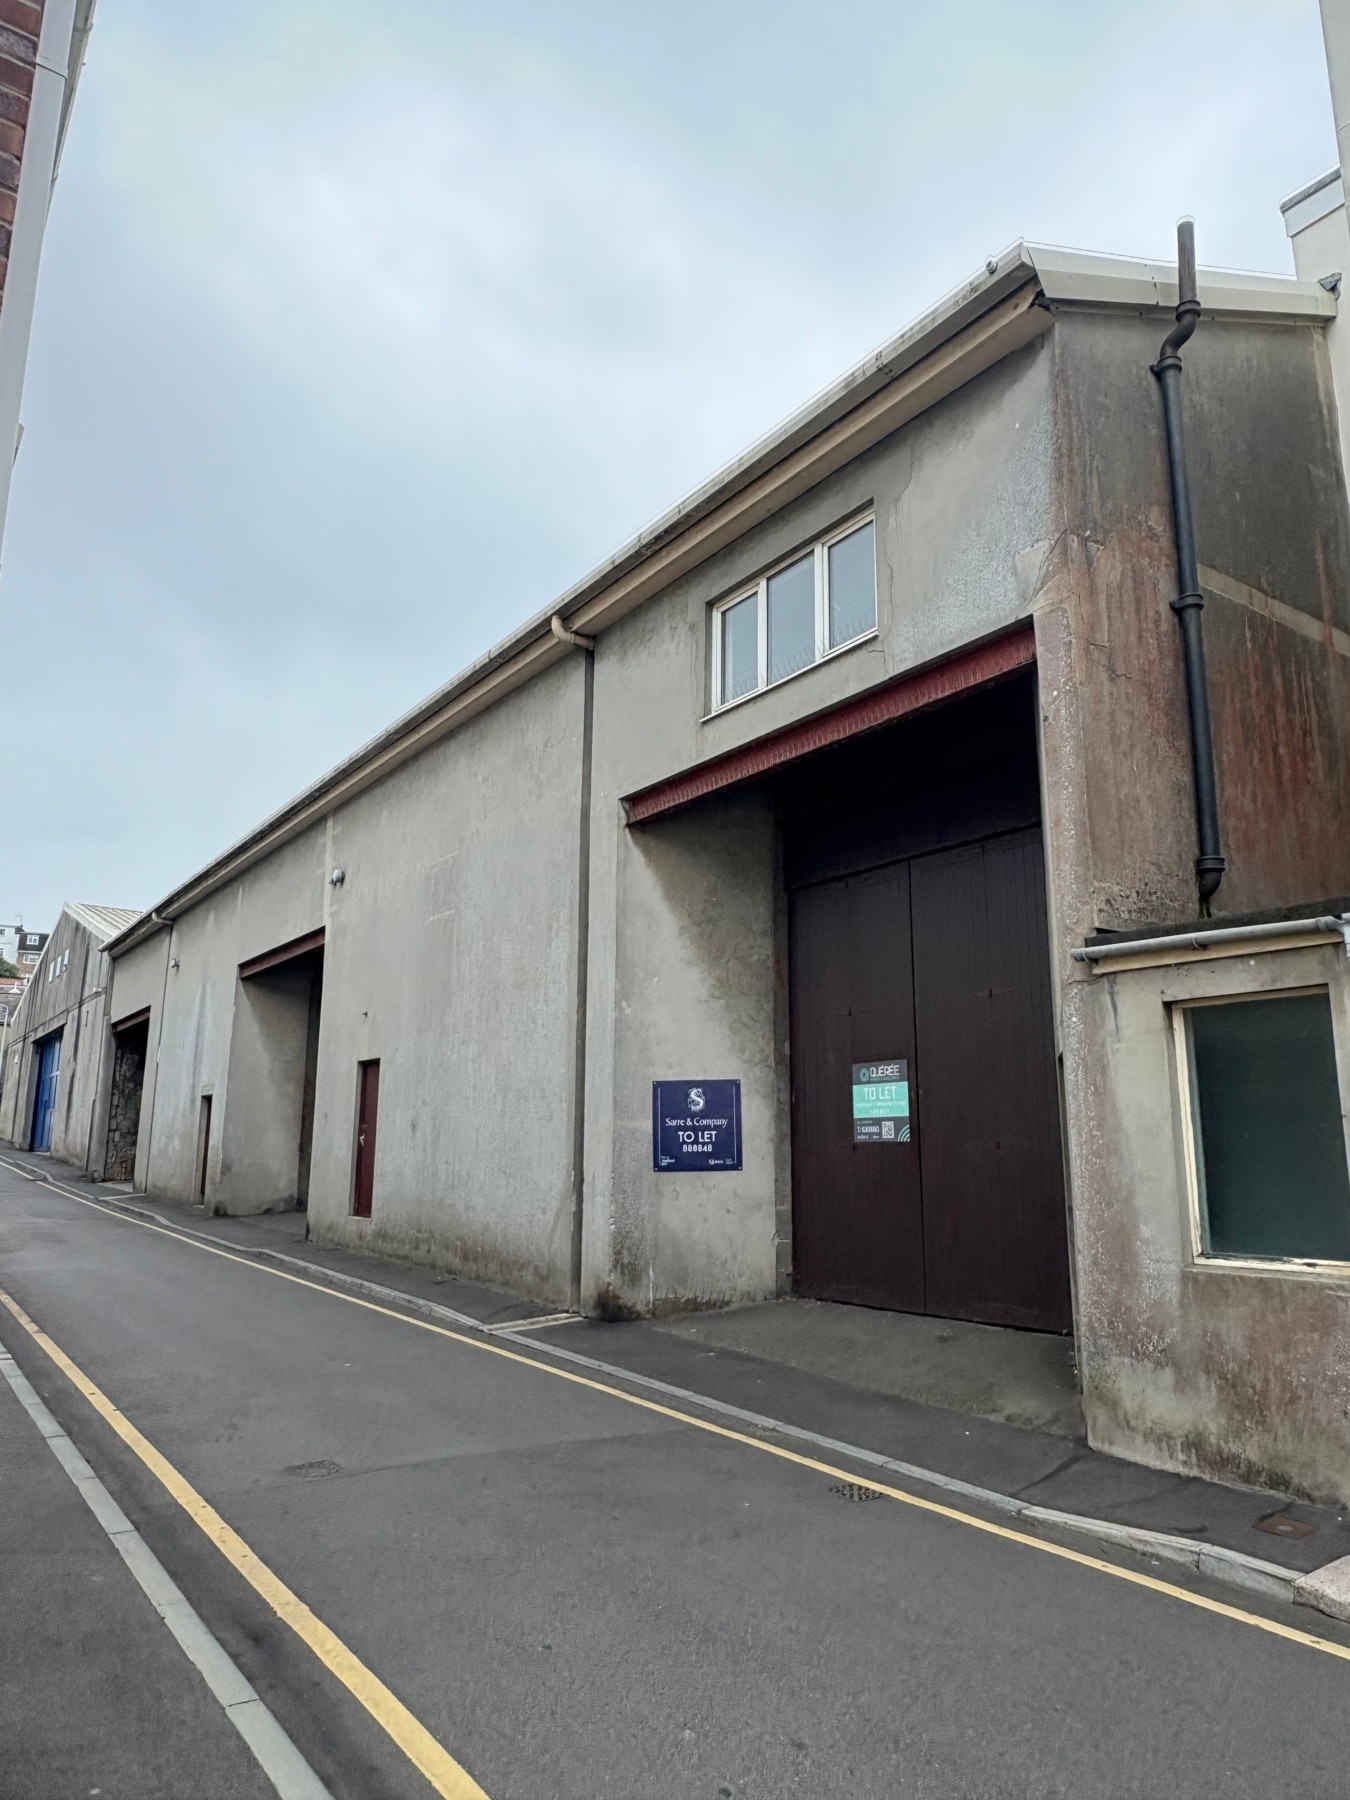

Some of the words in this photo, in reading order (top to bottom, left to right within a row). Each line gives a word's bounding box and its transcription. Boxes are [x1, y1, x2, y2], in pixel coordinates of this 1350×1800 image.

[863, 1087, 876, 1101] TO
[879, 1085, 897, 1100] LET
[665, 1117, 685, 1126] Sarre
[686, 1117, 693, 1126] &
[693, 1117, 728, 1128] Company
[677, 1131, 695, 1142] TO
[698, 1131, 717, 1142] LET
